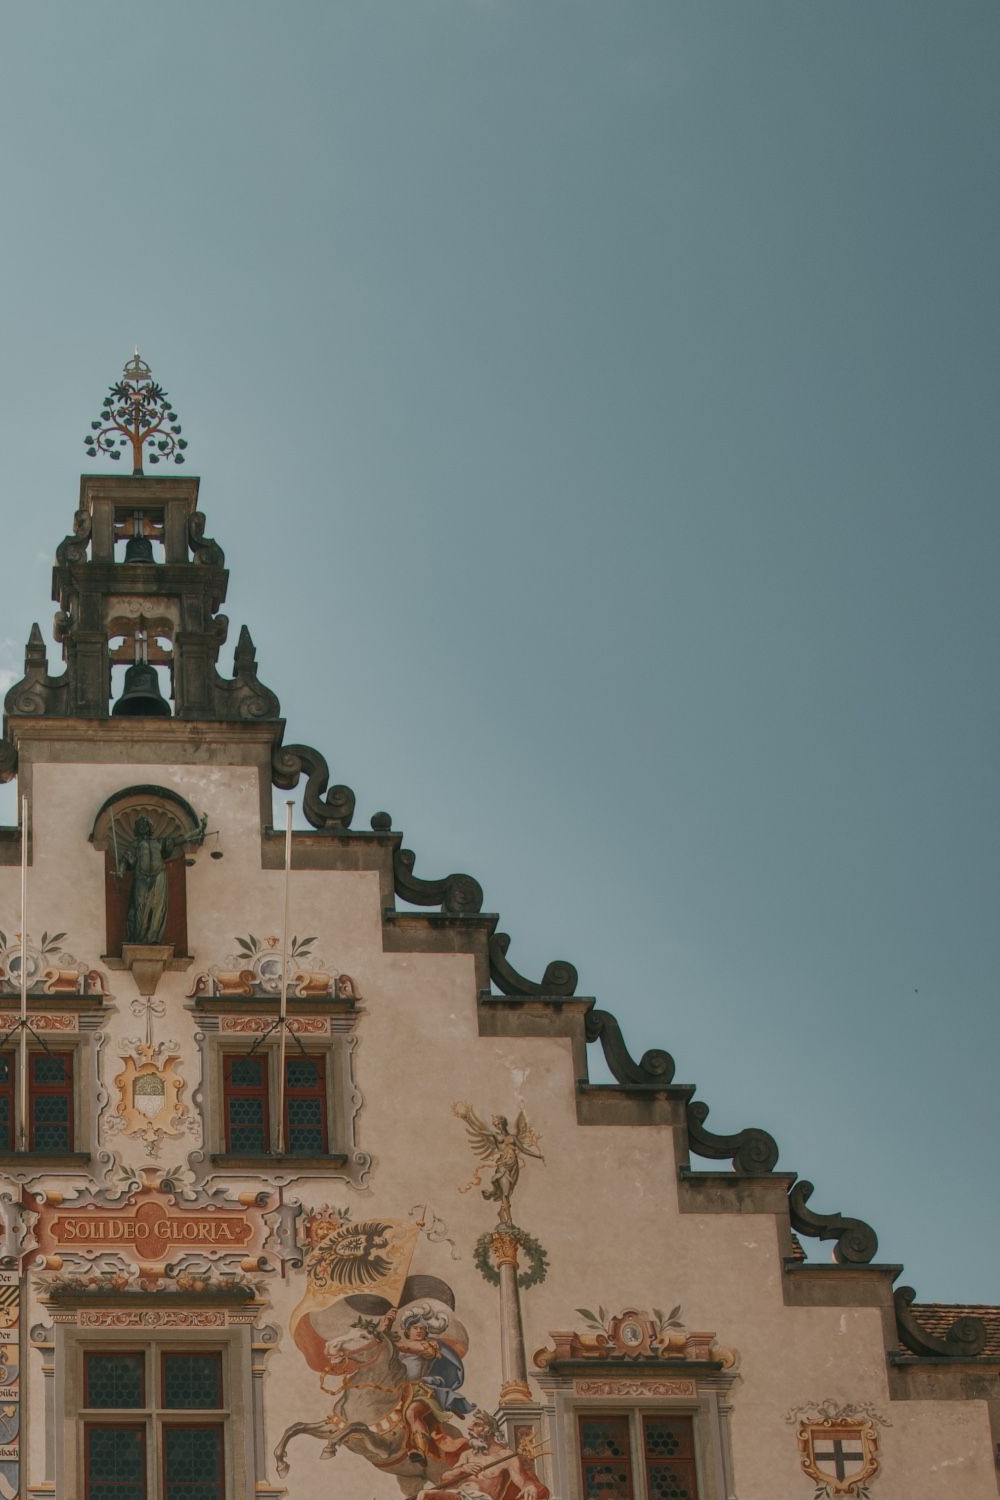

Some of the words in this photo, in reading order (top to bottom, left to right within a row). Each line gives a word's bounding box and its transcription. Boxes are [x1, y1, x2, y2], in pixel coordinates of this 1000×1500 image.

[64, 1219, 105, 1239] SOLI
[108, 1219, 150, 1239] DEO
[154, 1219, 235, 1242] GLORIA
